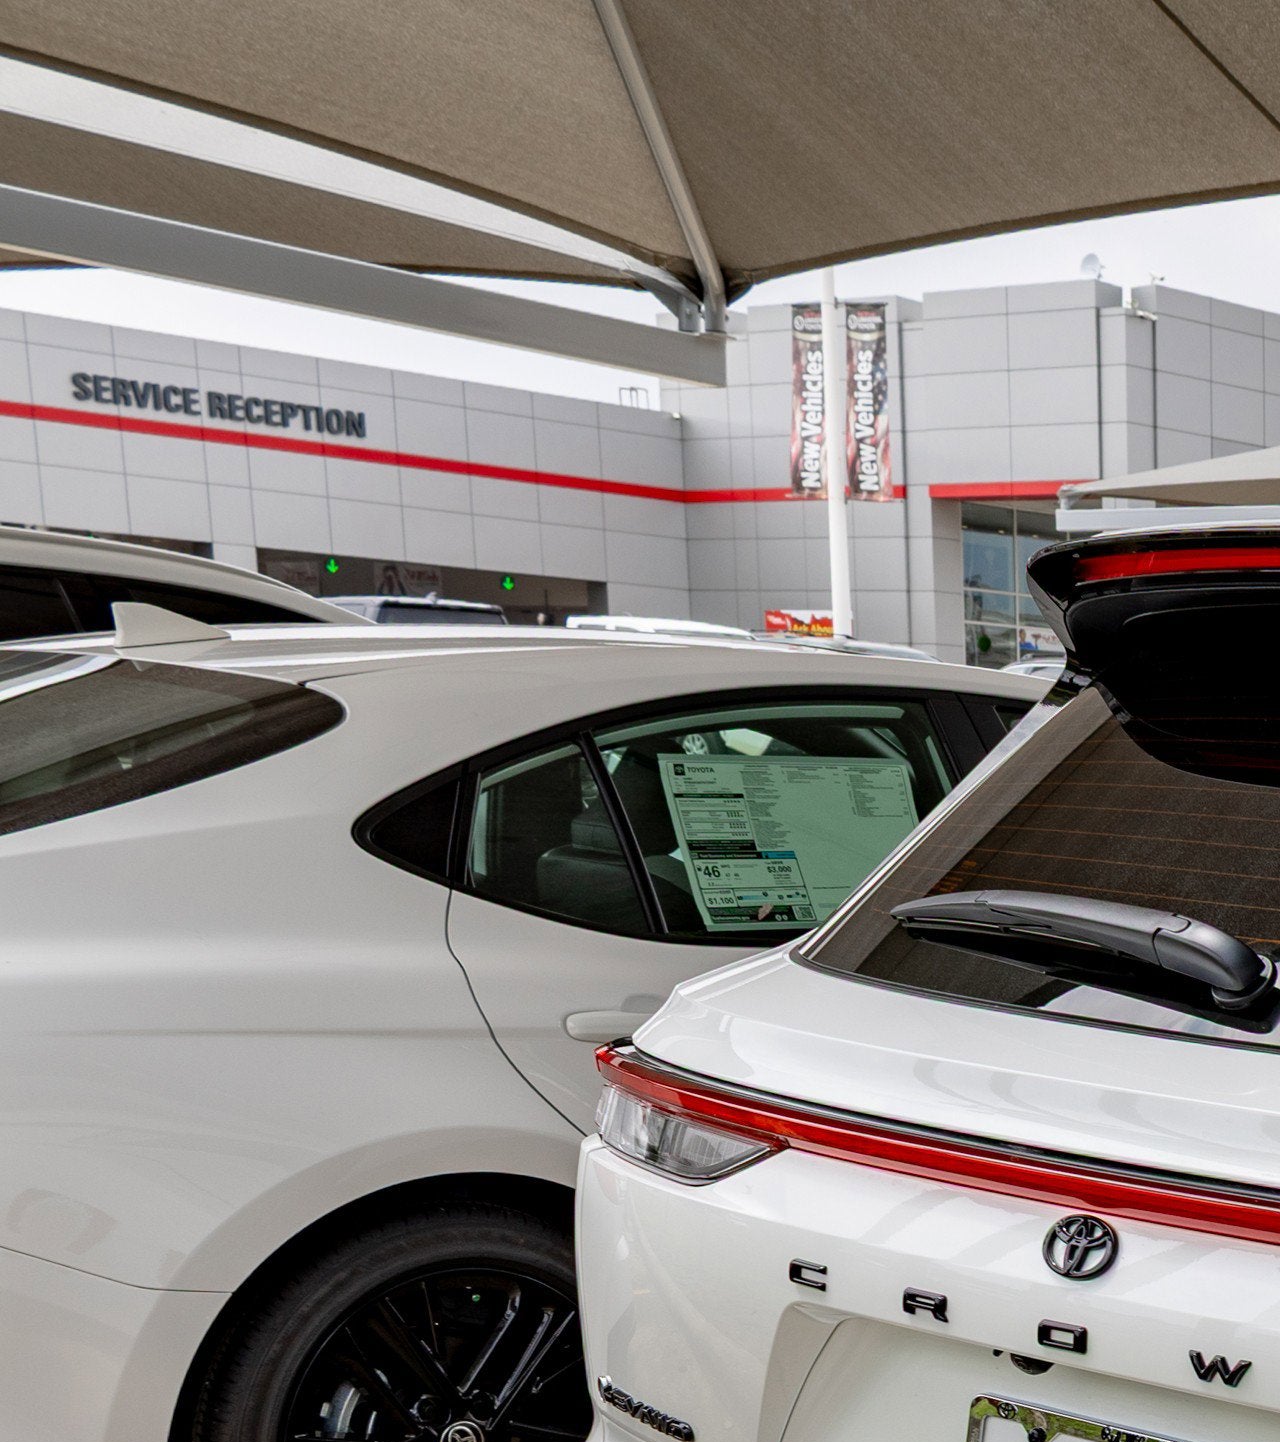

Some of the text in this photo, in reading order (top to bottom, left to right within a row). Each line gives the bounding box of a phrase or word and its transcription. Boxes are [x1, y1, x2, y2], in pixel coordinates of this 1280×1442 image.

[70, 372, 366, 438] SERVICE RECEPTION
[801, 350, 824, 438] Vehicles
[854, 349, 876, 440] Vehicles
[801, 440, 822, 488] New
[857, 446, 880, 492] New
[703, 865, 721, 878] 46
